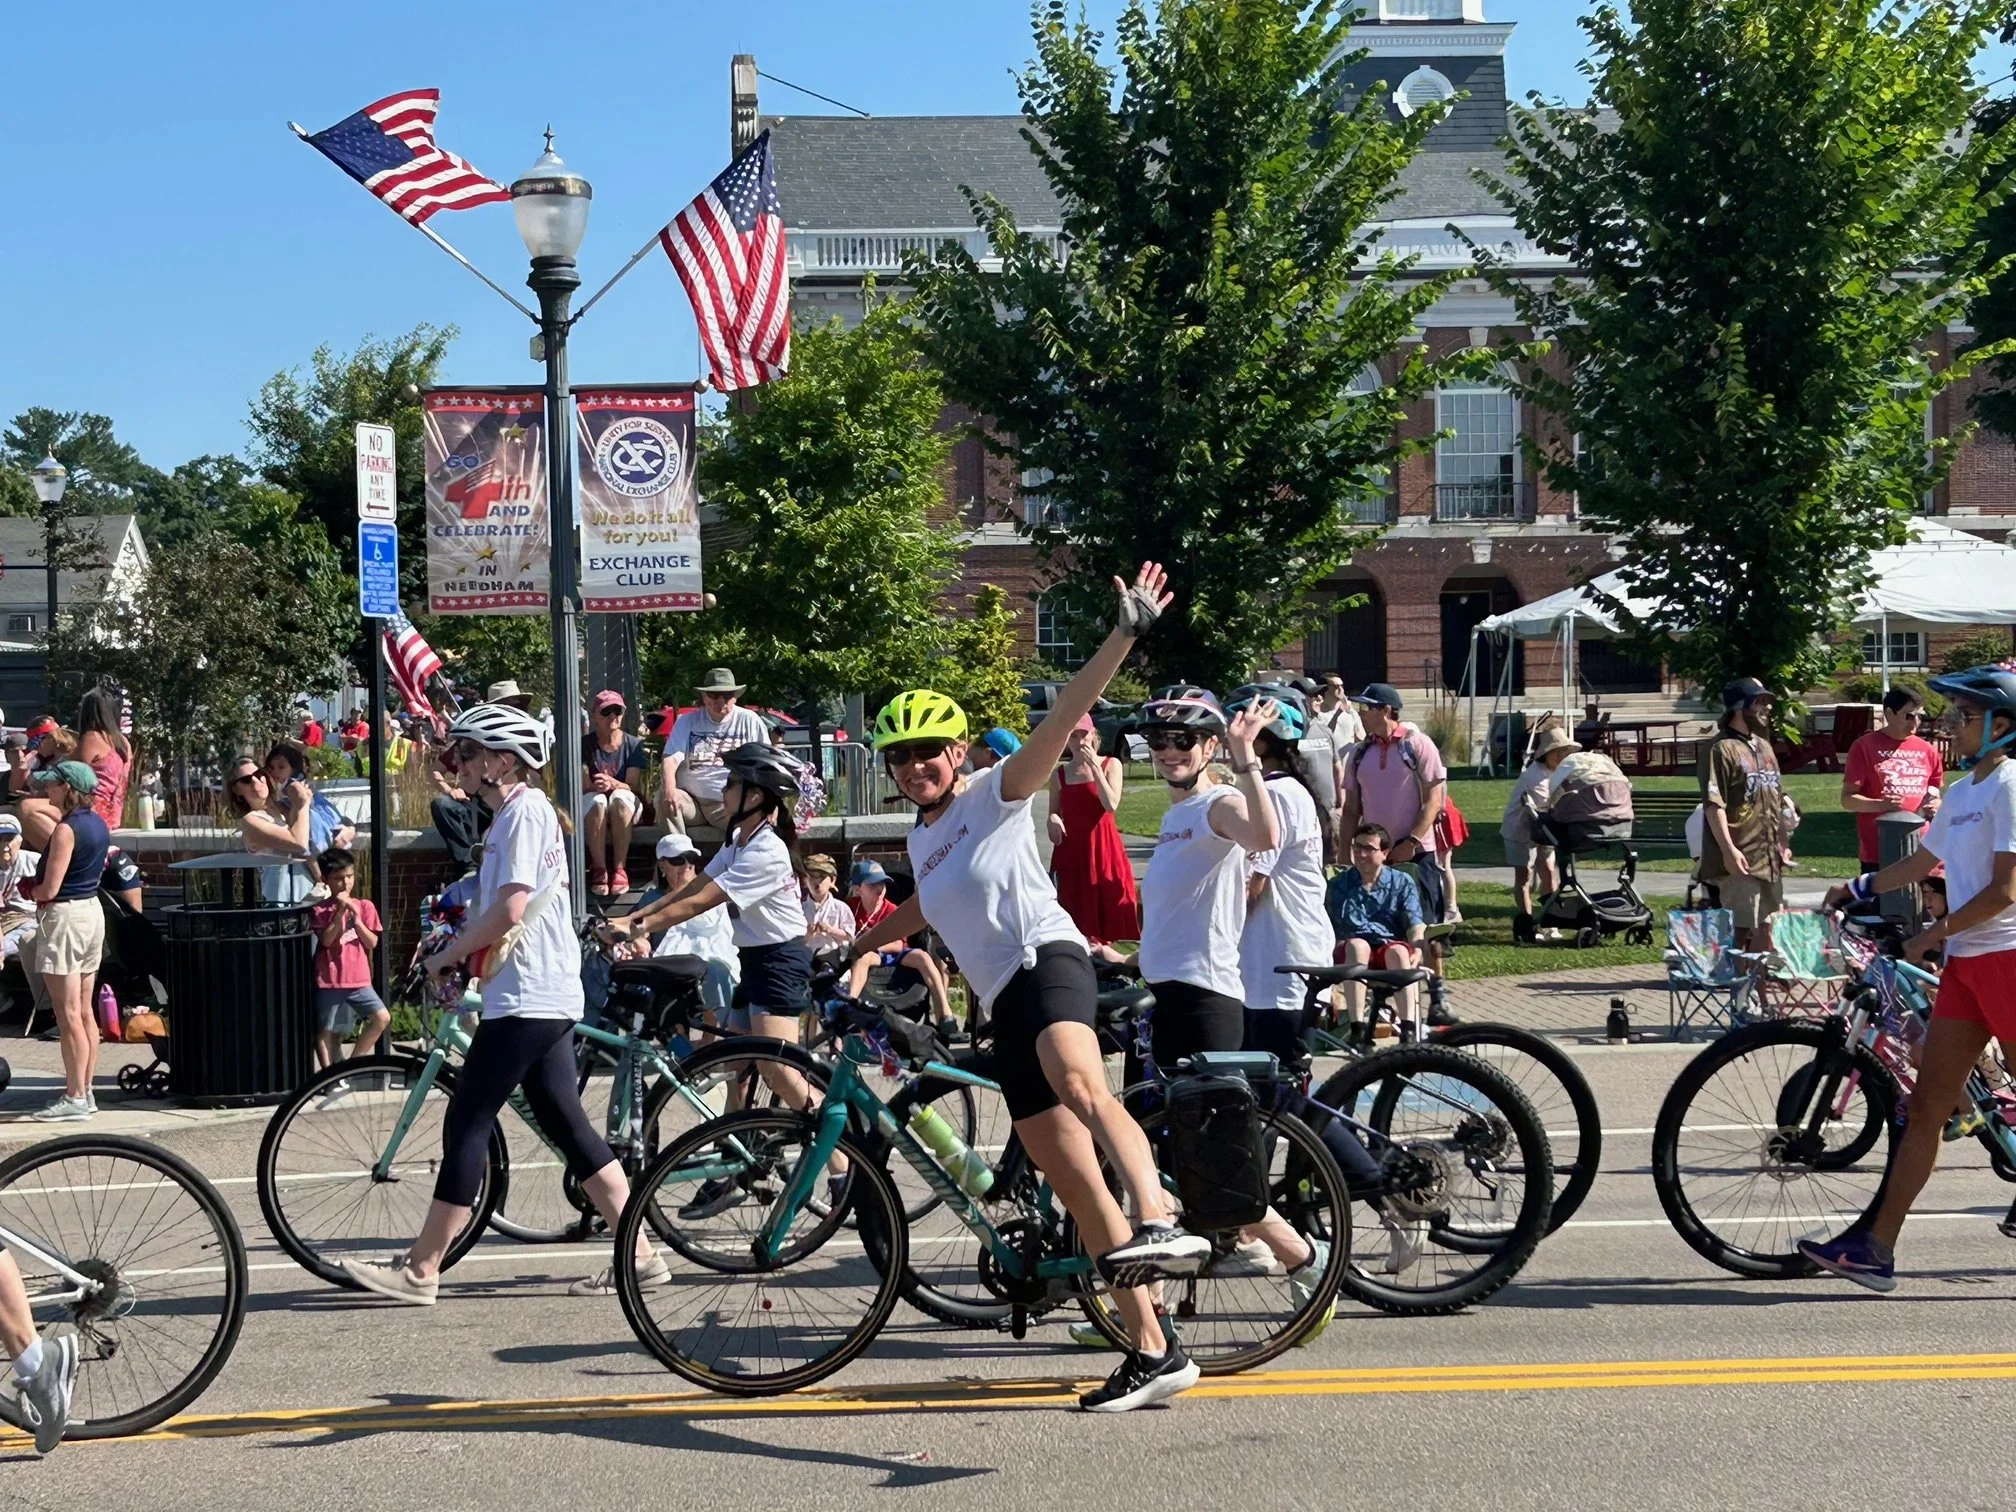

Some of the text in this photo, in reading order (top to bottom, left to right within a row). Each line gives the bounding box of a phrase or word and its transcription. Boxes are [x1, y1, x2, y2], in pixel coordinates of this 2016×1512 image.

[624, 420, 642, 430] FOR
[369, 432, 382, 451] NO
[445, 454, 480, 468] GO
[489, 505, 530, 517] AND
[591, 508, 691, 526] We do it all
[603, 528, 679, 546] for you!
[478, 564, 497, 576] IN
[589, 555, 691, 571] EXCHANGE
[616, 572, 667, 587] CLUB
[443, 581, 534, 593] NEEDHAM
